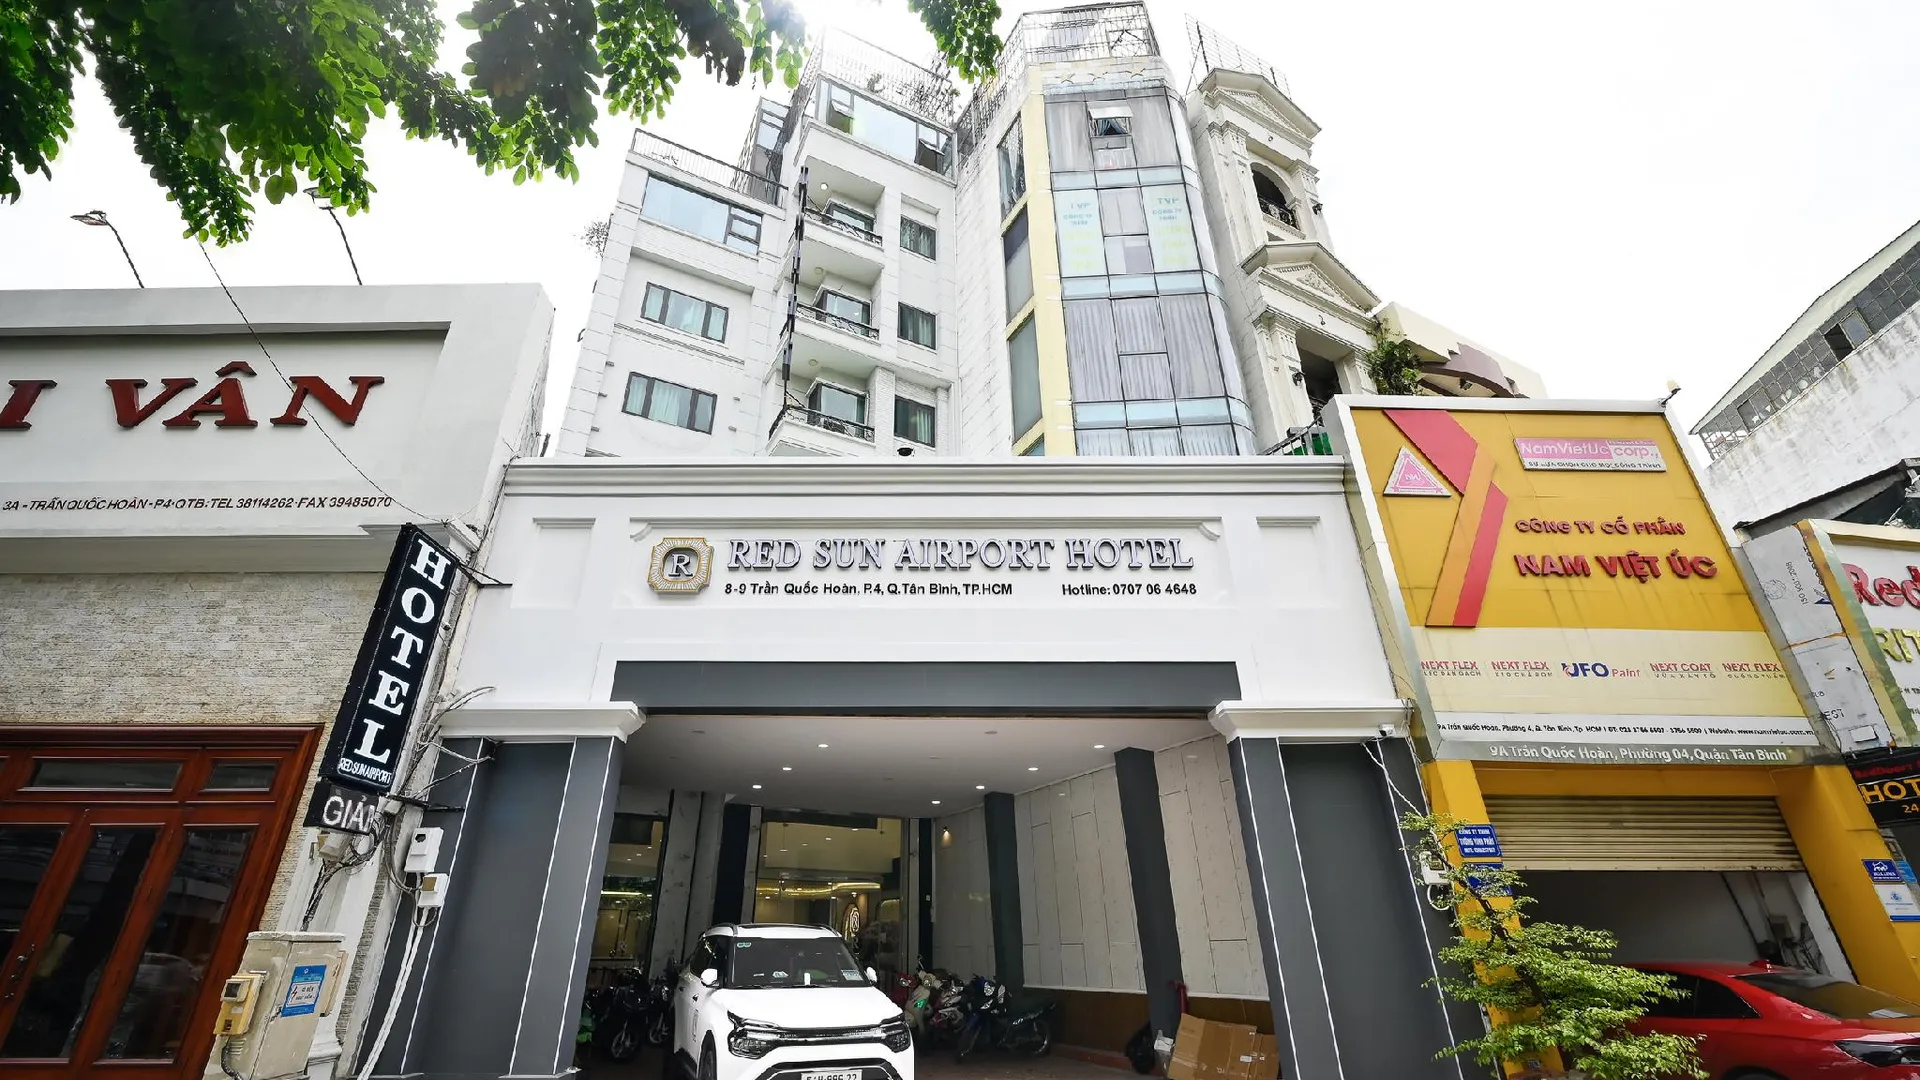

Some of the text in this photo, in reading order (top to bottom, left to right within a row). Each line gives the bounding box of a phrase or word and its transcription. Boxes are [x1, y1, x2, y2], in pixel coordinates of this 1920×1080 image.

[105, 361, 385, 427] VÂN
[1521, 442, 1610, 455] NamVietUc
[1515, 517, 1572, 534] CÔNG
[1574, 520, 1595, 534] TY
[727, 538, 1195, 571] RED SUN AIRPORT HOTEL
[1513, 548, 1718, 583] NAM VIỆT ÚC
[724, 583, 747, 595] 8-9
[750, 580, 779, 595] Trần
[783, 580, 819, 595] Quốc
[823, 583, 860, 596] Hoàn,
[962, 583, 1013, 595] TP.HCM
[1112, 583, 1143, 595] 0707
[1146, 583, 1161, 595] 06
[1165, 583, 1197, 595] 4648
[353, 538, 452, 765] HOTEL
[1420, 660, 1479, 671] NEXT FLEX
[1491, 661, 1550, 671] NEXT FLEX
[1561, 662, 1610, 678] UFO
[1612, 668, 1641, 678] Paint
[1650, 662, 1712, 672] NEXT COAT
[1722, 662, 1781, 673] NEXT FLEX
[1540, 746, 1576, 758] Quốc
[1619, 748, 1672, 762] Phường
[1729, 748, 1755, 760] Tân
